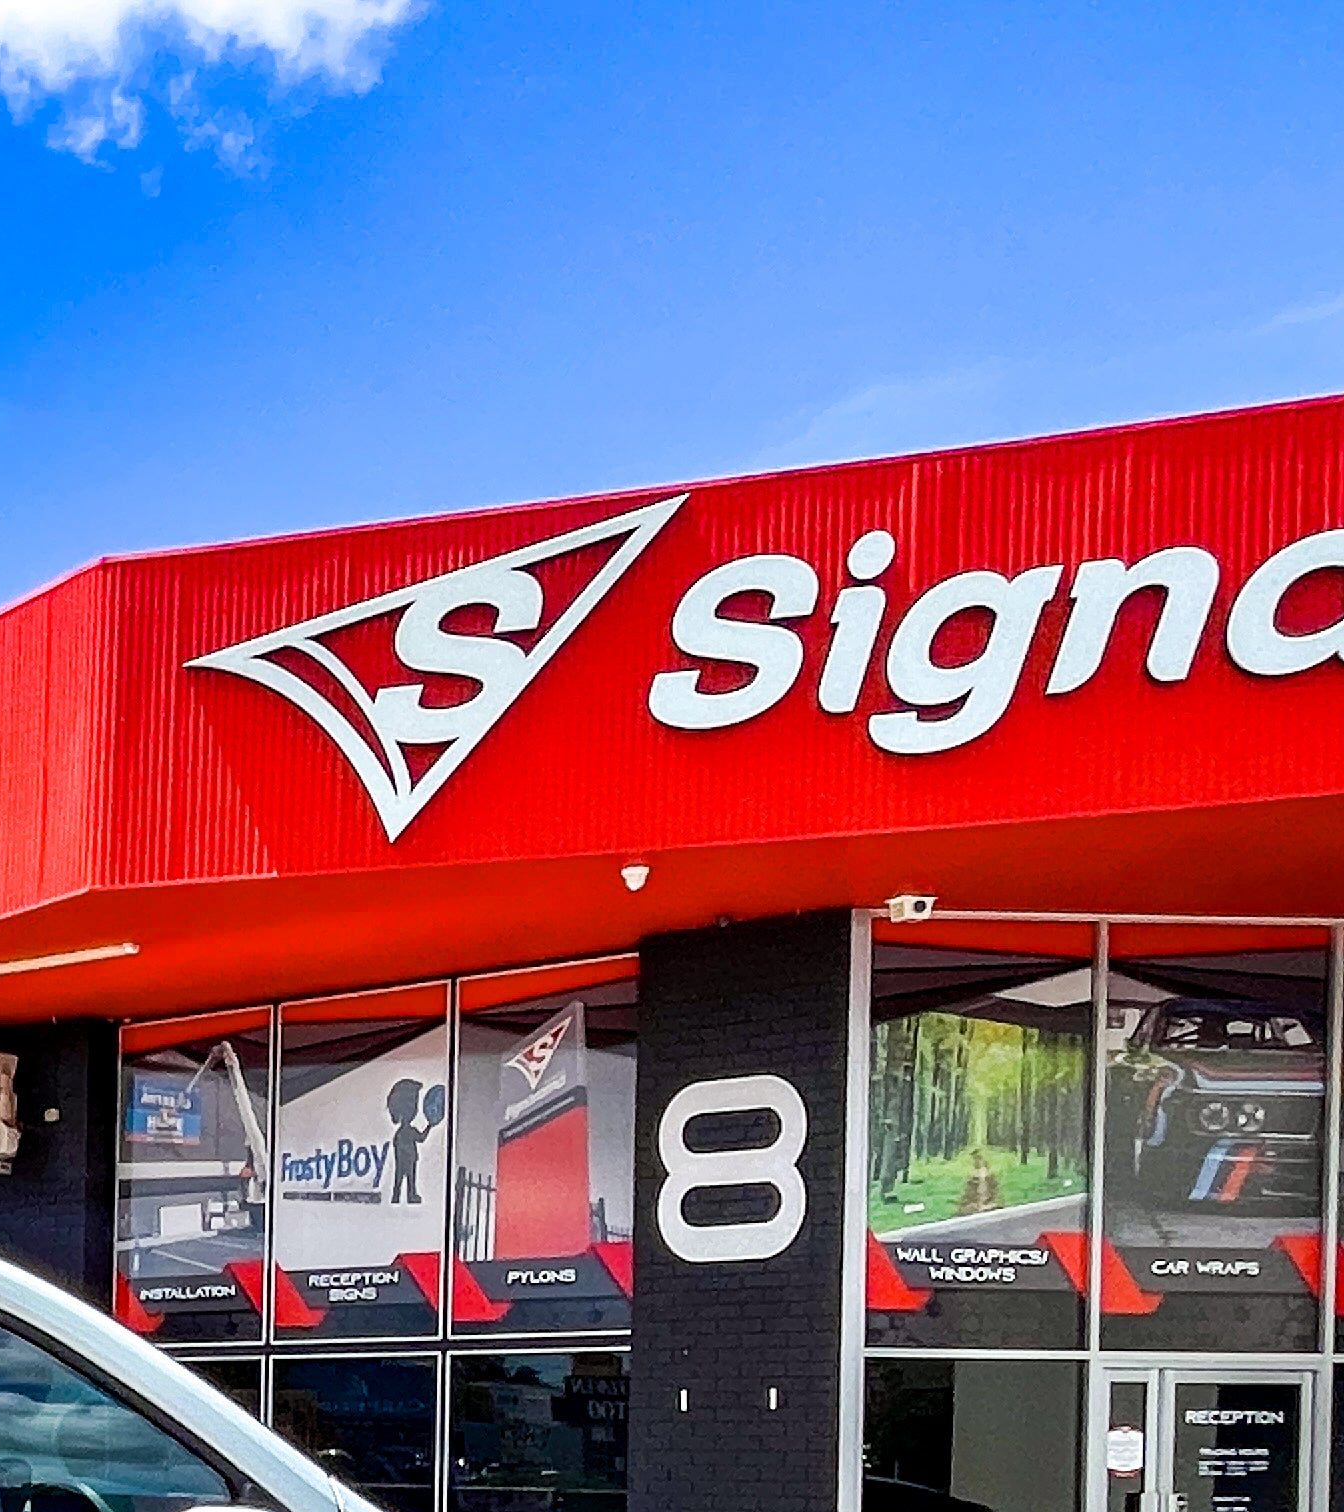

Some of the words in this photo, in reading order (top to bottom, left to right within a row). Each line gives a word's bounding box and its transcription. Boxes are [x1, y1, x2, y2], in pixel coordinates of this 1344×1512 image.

[656, 1075, 809, 1263] 8
[896, 1247, 944, 1264] WALL
[950, 1248, 1050, 1266] GRAPHICS/
[928, 1265, 1016, 1282] WINDOWS
[1150, 1259, 1190, 1275] CAR
[1196, 1259, 1261, 1276] WRAPS
[308, 1270, 400, 1288] RECEPTION
[506, 1268, 577, 1285] PYLONS
[139, 1284, 236, 1301] INSTALLATION
[327, 1286, 378, 1302] SIGNS
[1185, 1410, 1285, 1425] RECEPTION
